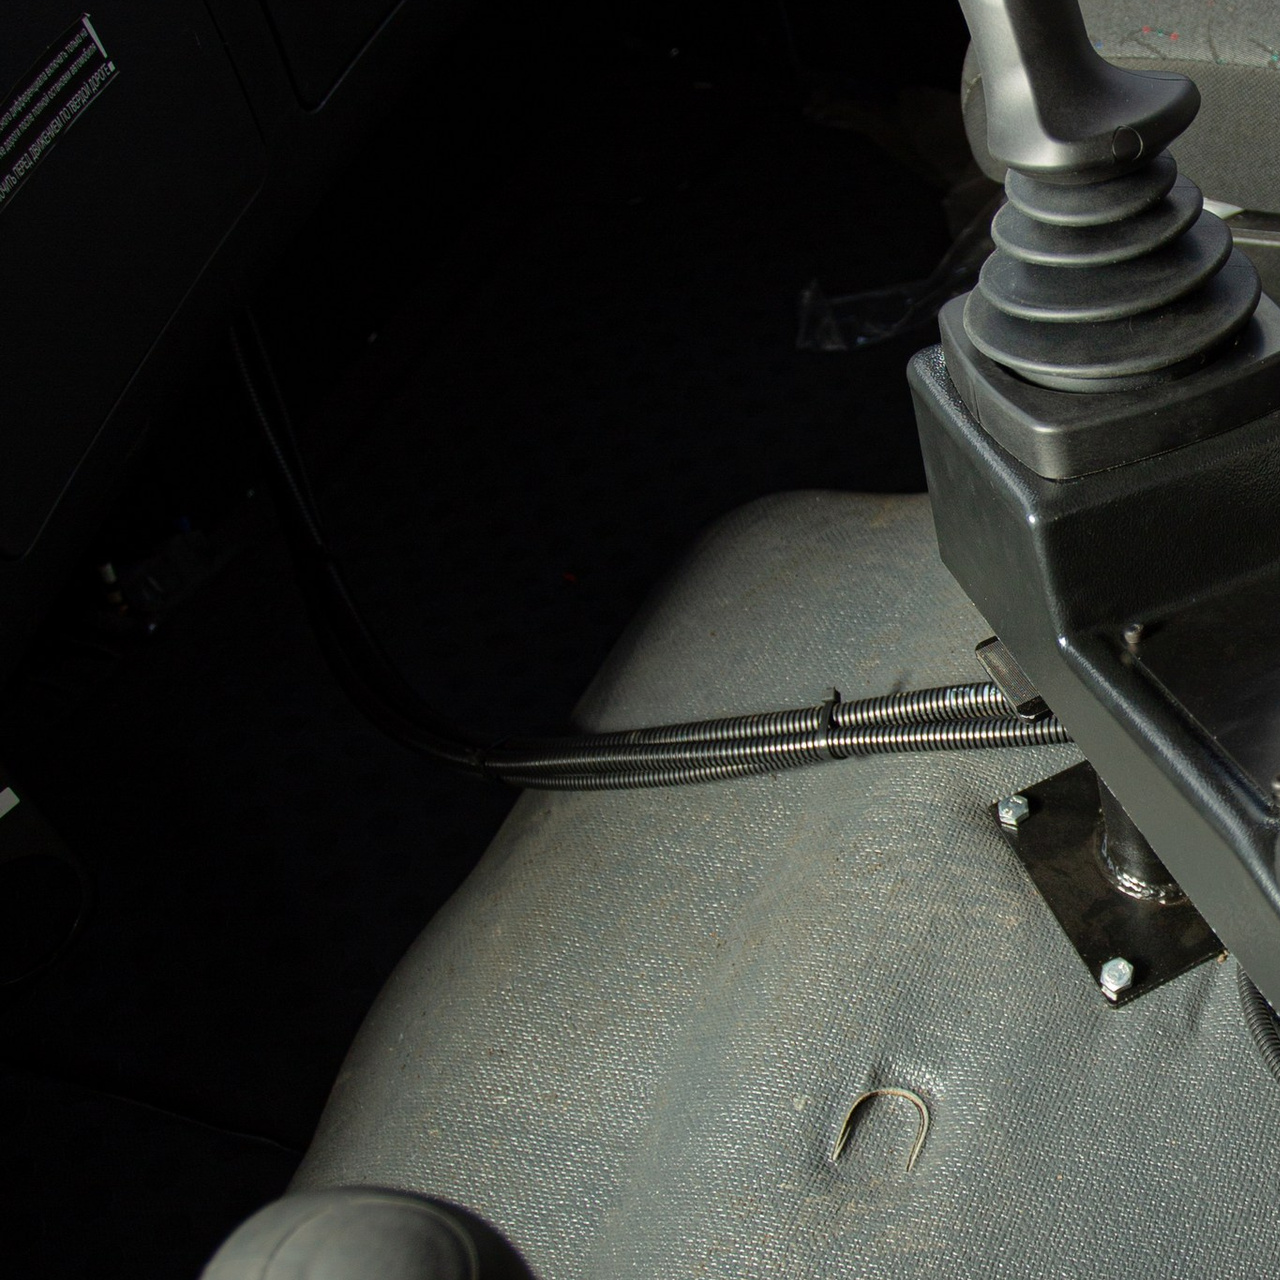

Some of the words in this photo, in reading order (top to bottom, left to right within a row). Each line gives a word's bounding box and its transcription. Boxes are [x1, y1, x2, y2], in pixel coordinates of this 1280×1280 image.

[12, 153, 34, 179] ПЕРЕД
[28, 116, 63, 163] ДВИЖЕНИЕМ
[59, 107, 71, 124] ПО
[66, 81, 92, 115] ТВЕРДОЙ
[88, 63, 111, 94] ДОРОГЕ
